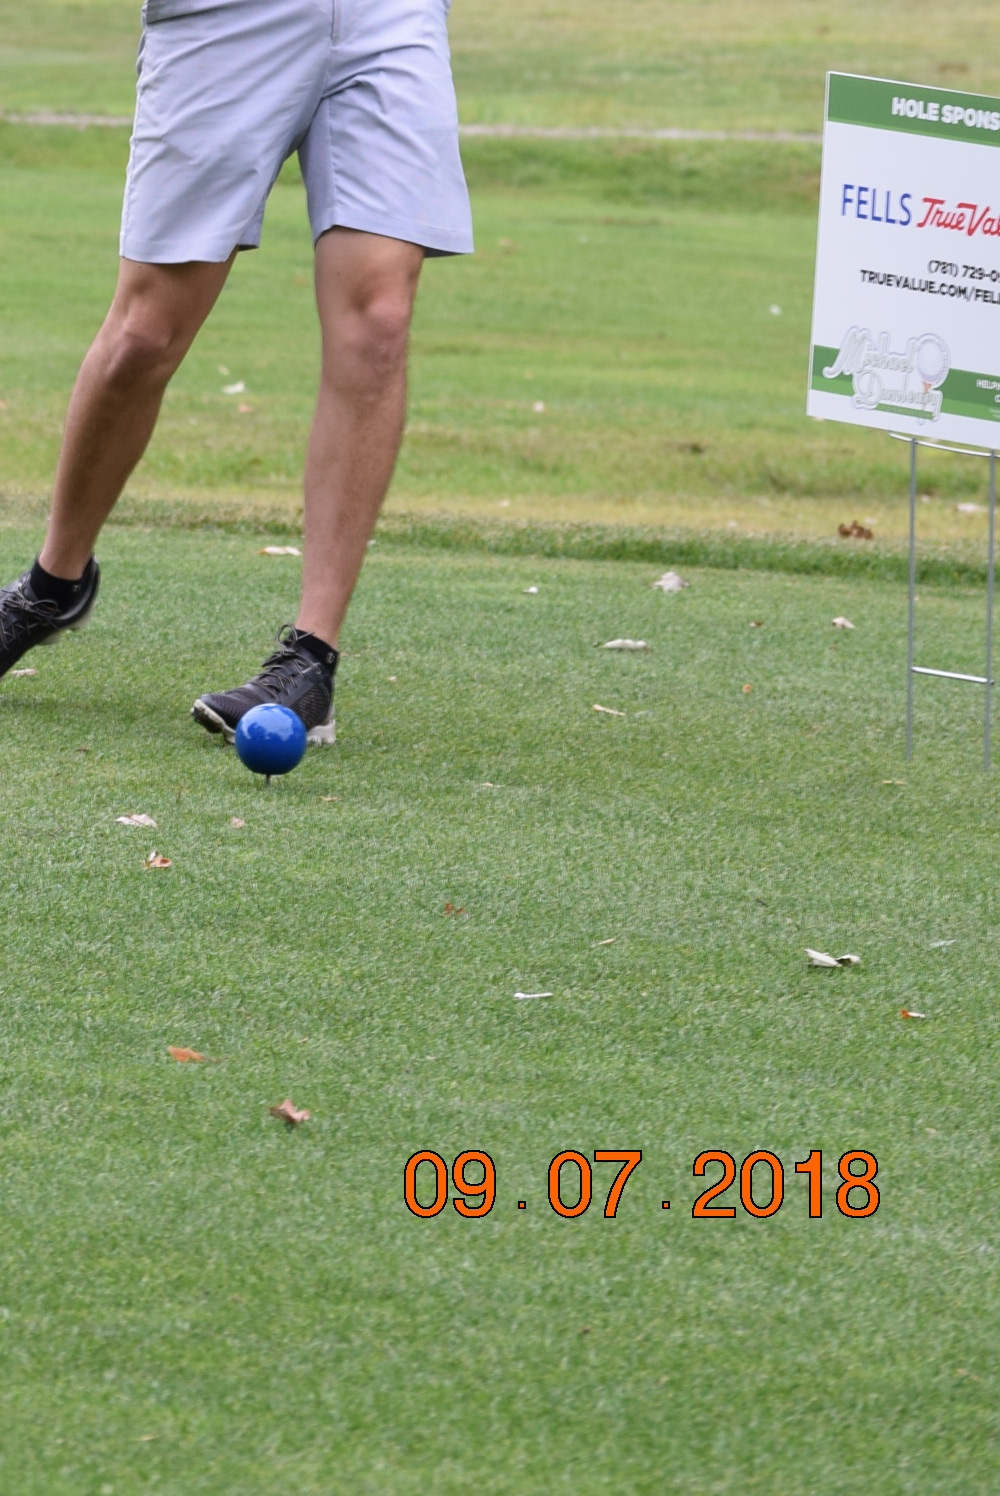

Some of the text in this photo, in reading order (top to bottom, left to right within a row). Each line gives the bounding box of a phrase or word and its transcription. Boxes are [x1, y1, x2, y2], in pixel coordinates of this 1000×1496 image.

[891, 97, 940, 122] HOLE
[841, 183, 1000, 237] FELLS TrueVa
